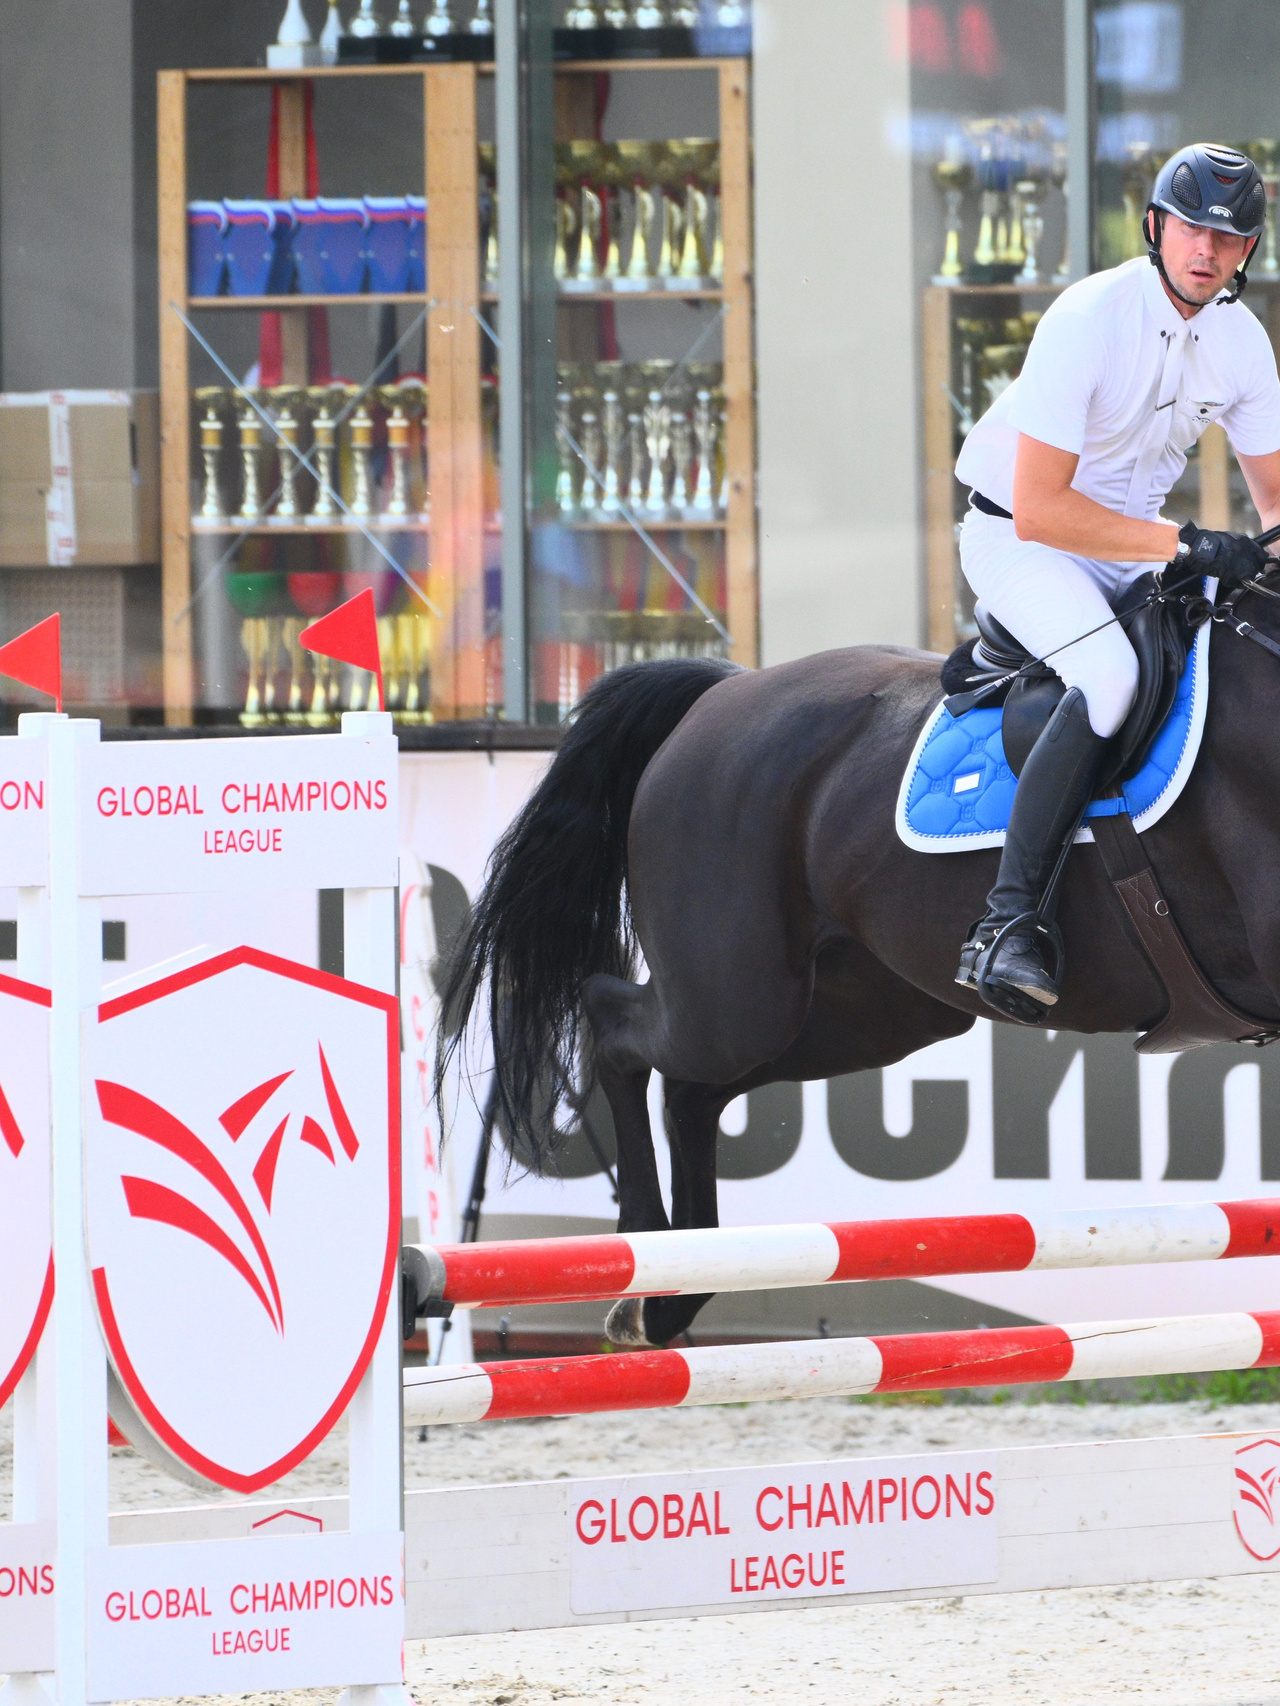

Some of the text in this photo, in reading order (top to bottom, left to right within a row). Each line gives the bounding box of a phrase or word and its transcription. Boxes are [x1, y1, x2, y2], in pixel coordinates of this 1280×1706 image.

[97, 779, 387, 817] GLOBAL CHAMPIONS
[204, 828, 282, 854] LEAGUE
[576, 1471, 995, 1545] GLOBAL CHAMPIONS
[730, 1550, 845, 1593] LEAGUE
[105, 1575, 394, 1622] GLOBAL CHAMPIONS
[212, 1627, 290, 1655] LEAGUE
